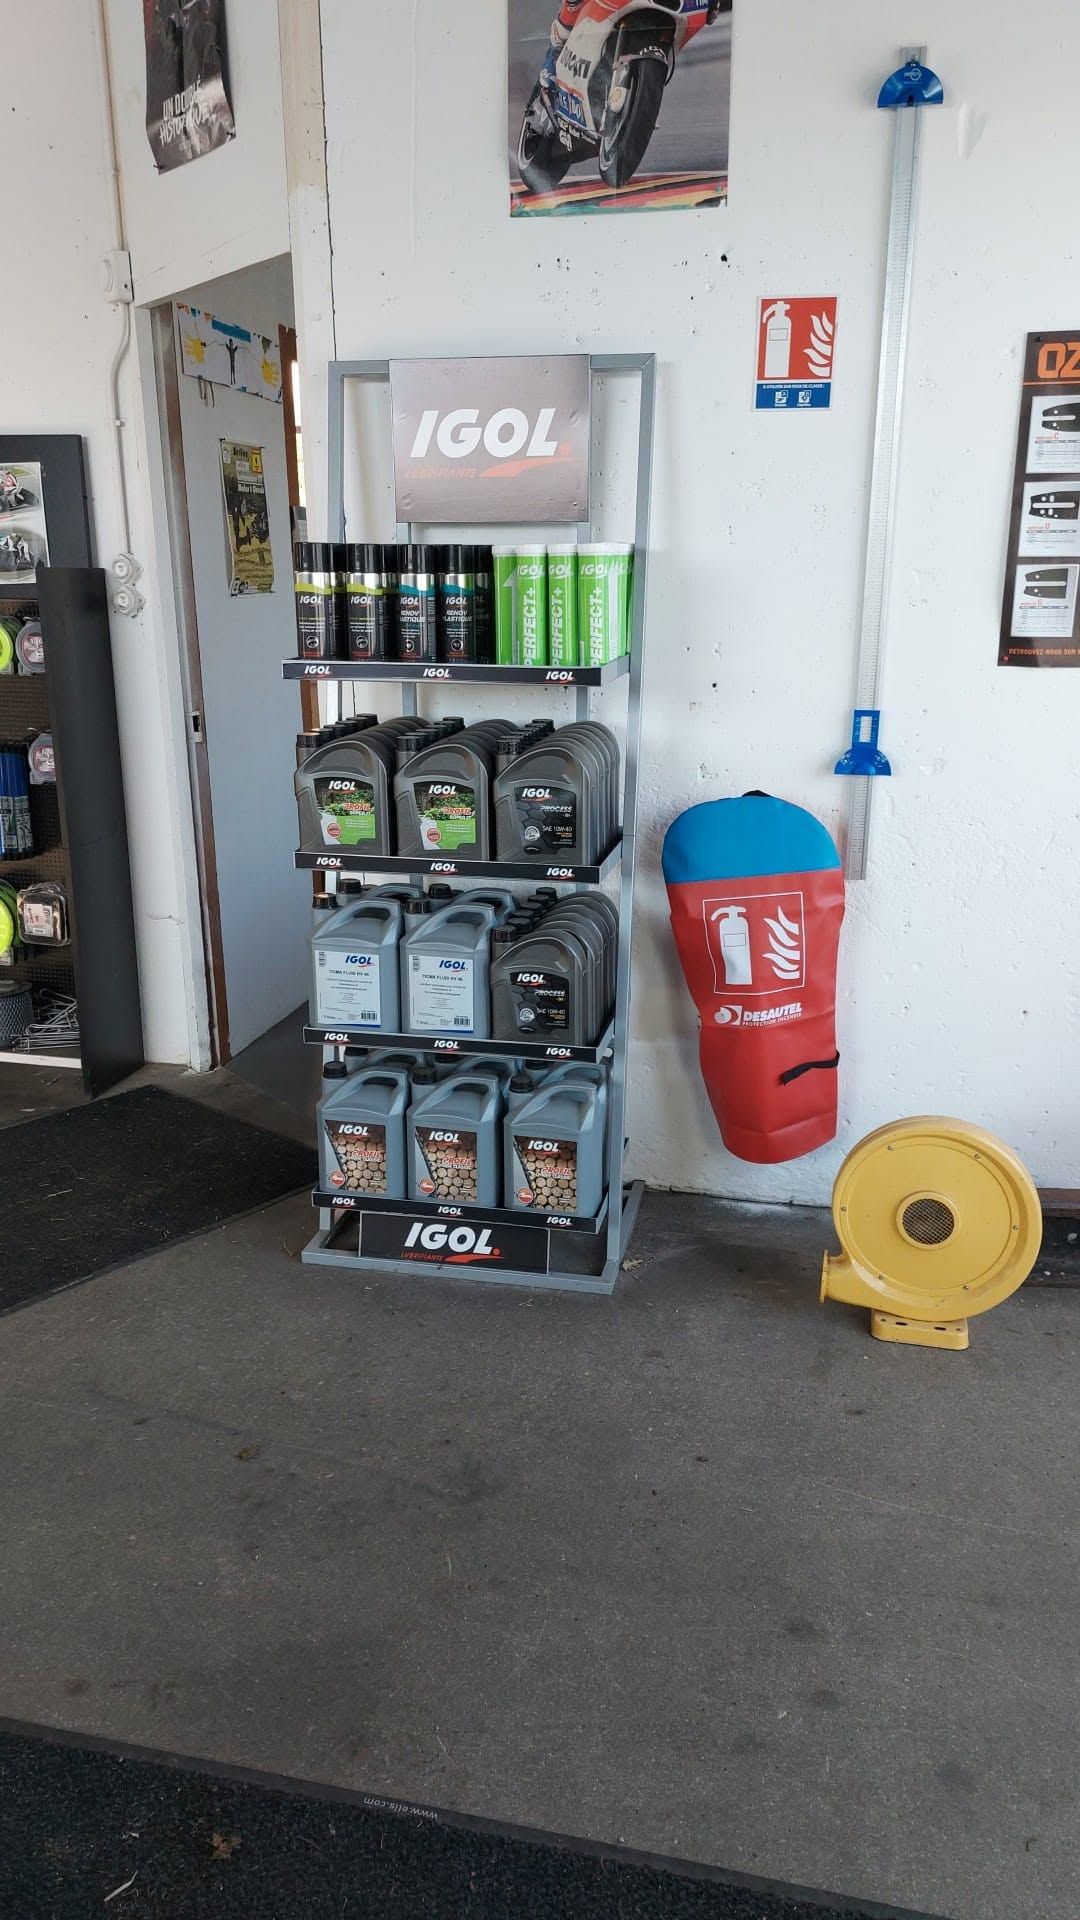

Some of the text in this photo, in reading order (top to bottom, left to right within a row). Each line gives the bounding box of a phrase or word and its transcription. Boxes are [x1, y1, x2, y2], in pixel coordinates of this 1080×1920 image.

[410, 408, 558, 458] IGOL
[517, 565, 545, 576] IGOL
[300, 596, 322, 604] IGOL
[350, 596, 372, 604] IGOL
[400, 597, 420, 605] IGOL
[446, 597, 467, 605] IGOL
[304, 665, 331, 675] IGOL
[422, 668, 451, 678] IGOL
[545, 671, 574, 681] IGOL
[328, 780, 356, 791] IGOL
[428, 784, 456, 795] IGOL
[521, 788, 551, 798] IGOL
[540, 805, 572, 813] PROCESS
[316, 857, 342, 866] IGOL
[430, 862, 456, 871] IGOL
[546, 867, 574, 877] IGOL
[345, 955, 372, 965] IGOL
[439, 959, 466, 970] IGOL
[516, 973, 545, 983] IGOL
[743, 1002, 803, 1022] DESAUTEL
[742, 1018, 776, 1027] PROTECTION
[324, 1033, 350, 1041] IGOL
[433, 1040, 459, 1049] IGOL
[545, 1047, 572, 1056] IGOL
[338, 1124, 368, 1136] IGOL
[429, 1131, 460, 1143] IGOL
[528, 1140, 560, 1152] IGOL
[352, 1150, 382, 1158] PROFIL
[541, 1167, 571, 1175] PROFIL
[332, 1197, 356, 1206] IGOL
[437, 1206, 462, 1215] IGOL
[547, 1216, 572, 1225] IGOL
[404, 1222, 493, 1255] IGOL
[401, 1251, 444, 1261] LUBRIFIANTS
